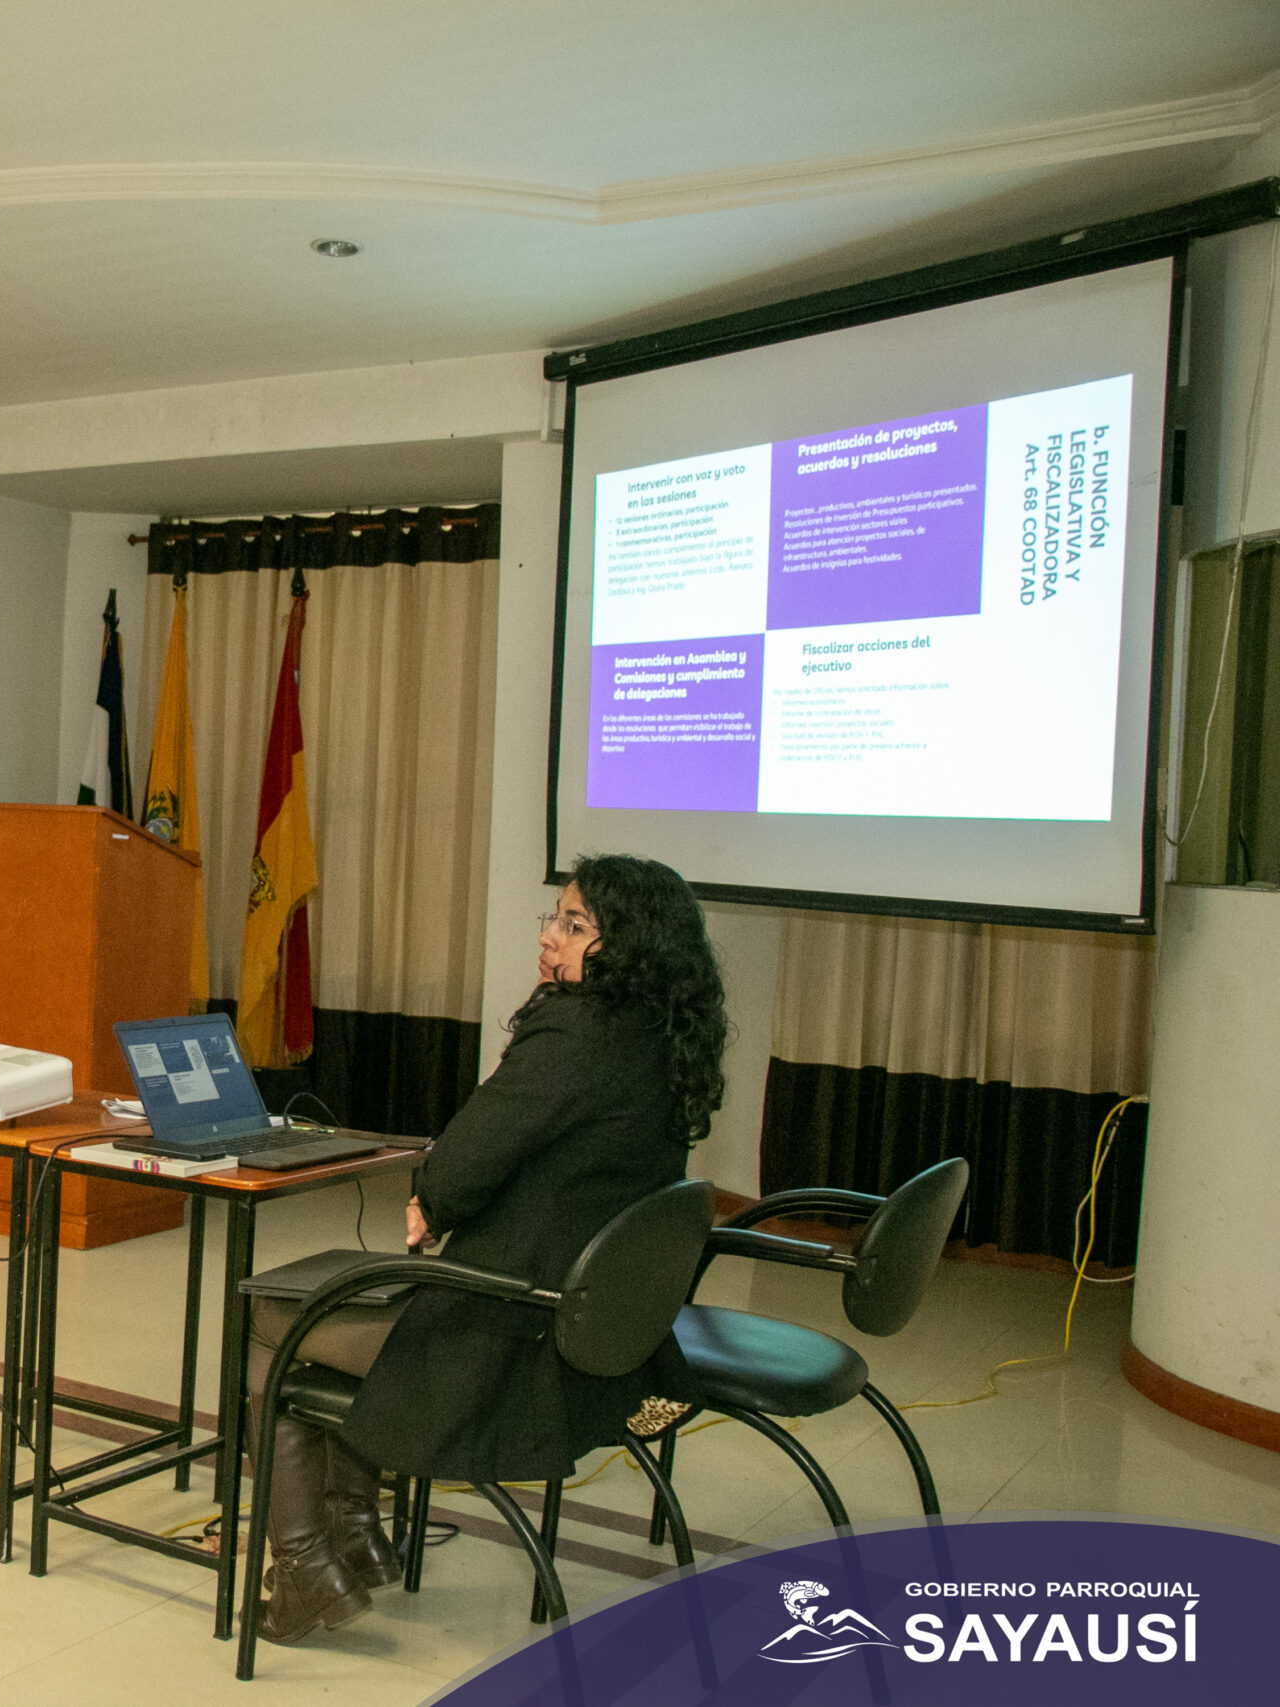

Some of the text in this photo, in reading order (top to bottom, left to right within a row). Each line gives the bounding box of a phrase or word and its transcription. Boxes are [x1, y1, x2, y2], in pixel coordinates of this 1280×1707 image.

[798, 420, 958, 457] Presentación de proyectos,
[798, 442, 937, 474] acuerdos y resoluciones
[628, 464, 745, 493] Intervenir con voz y voto
[1090, 425, 1109, 548] b. FUNCIÓN
[628, 499, 638, 508] en
[657, 490, 696, 503] sesiones
[1065, 429, 1086, 581] LEGISLATIVA Y
[1021, 444, 1039, 605] Art. 68 COOTAD
[1043, 434, 1062, 600] FISCALIZADORA
[615, 654, 671, 668] Intervención
[688, 650, 737, 664] Asamblea
[739, 652, 746, 663] y
[802, 636, 930, 655] Fiscalizar acciones del
[614, 667, 745, 684] Comisiones y cumplimiento
[802, 660, 852, 676] ejecutivo
[614, 688, 687, 702] de delegaciones
